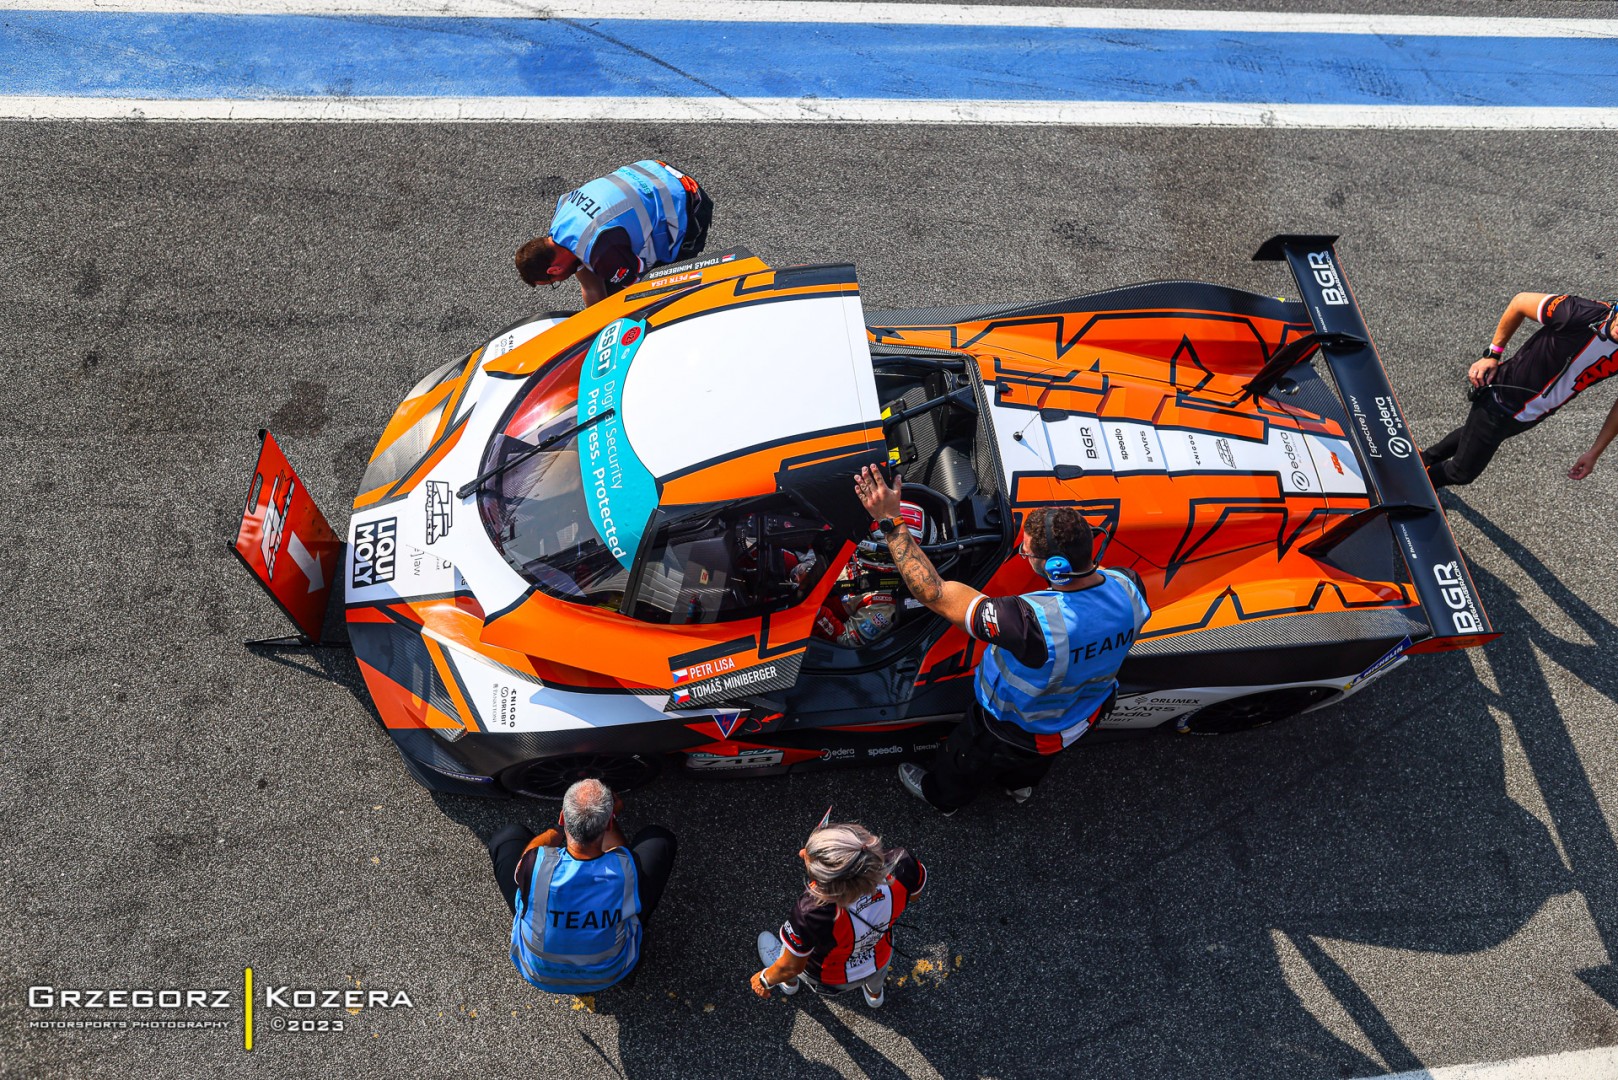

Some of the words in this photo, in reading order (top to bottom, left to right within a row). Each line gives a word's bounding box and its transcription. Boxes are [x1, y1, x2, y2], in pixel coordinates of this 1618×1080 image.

[649, 263, 693, 279] MINIBERGER
[651, 279, 668, 288] LISA
[670, 273, 689, 284] PETR
[1307, 252, 1344, 305] BGR
[601, 380, 616, 427] Digial
[1375, 396, 1397, 436] edera
[605, 427, 623, 489] Security
[1080, 427, 1097, 459] BGR
[1140, 430, 1151, 455] VARS
[1280, 432, 1299, 469] edera
[592, 467, 627, 559] Protected
[354, 523, 375, 585] MOLY
[374, 519, 396, 582] LIQUI
[1433, 562, 1478, 634] BGR
[1070, 627, 1135, 665] TEAM
[689, 663, 713, 679] PETR
[714, 657, 736, 673] LISA
[691, 678, 723, 699] TOMÁŠ
[724, 666, 778, 689] MINIBERGER
[832, 748, 855, 756] edera
[549, 908, 622, 929] TEAM
